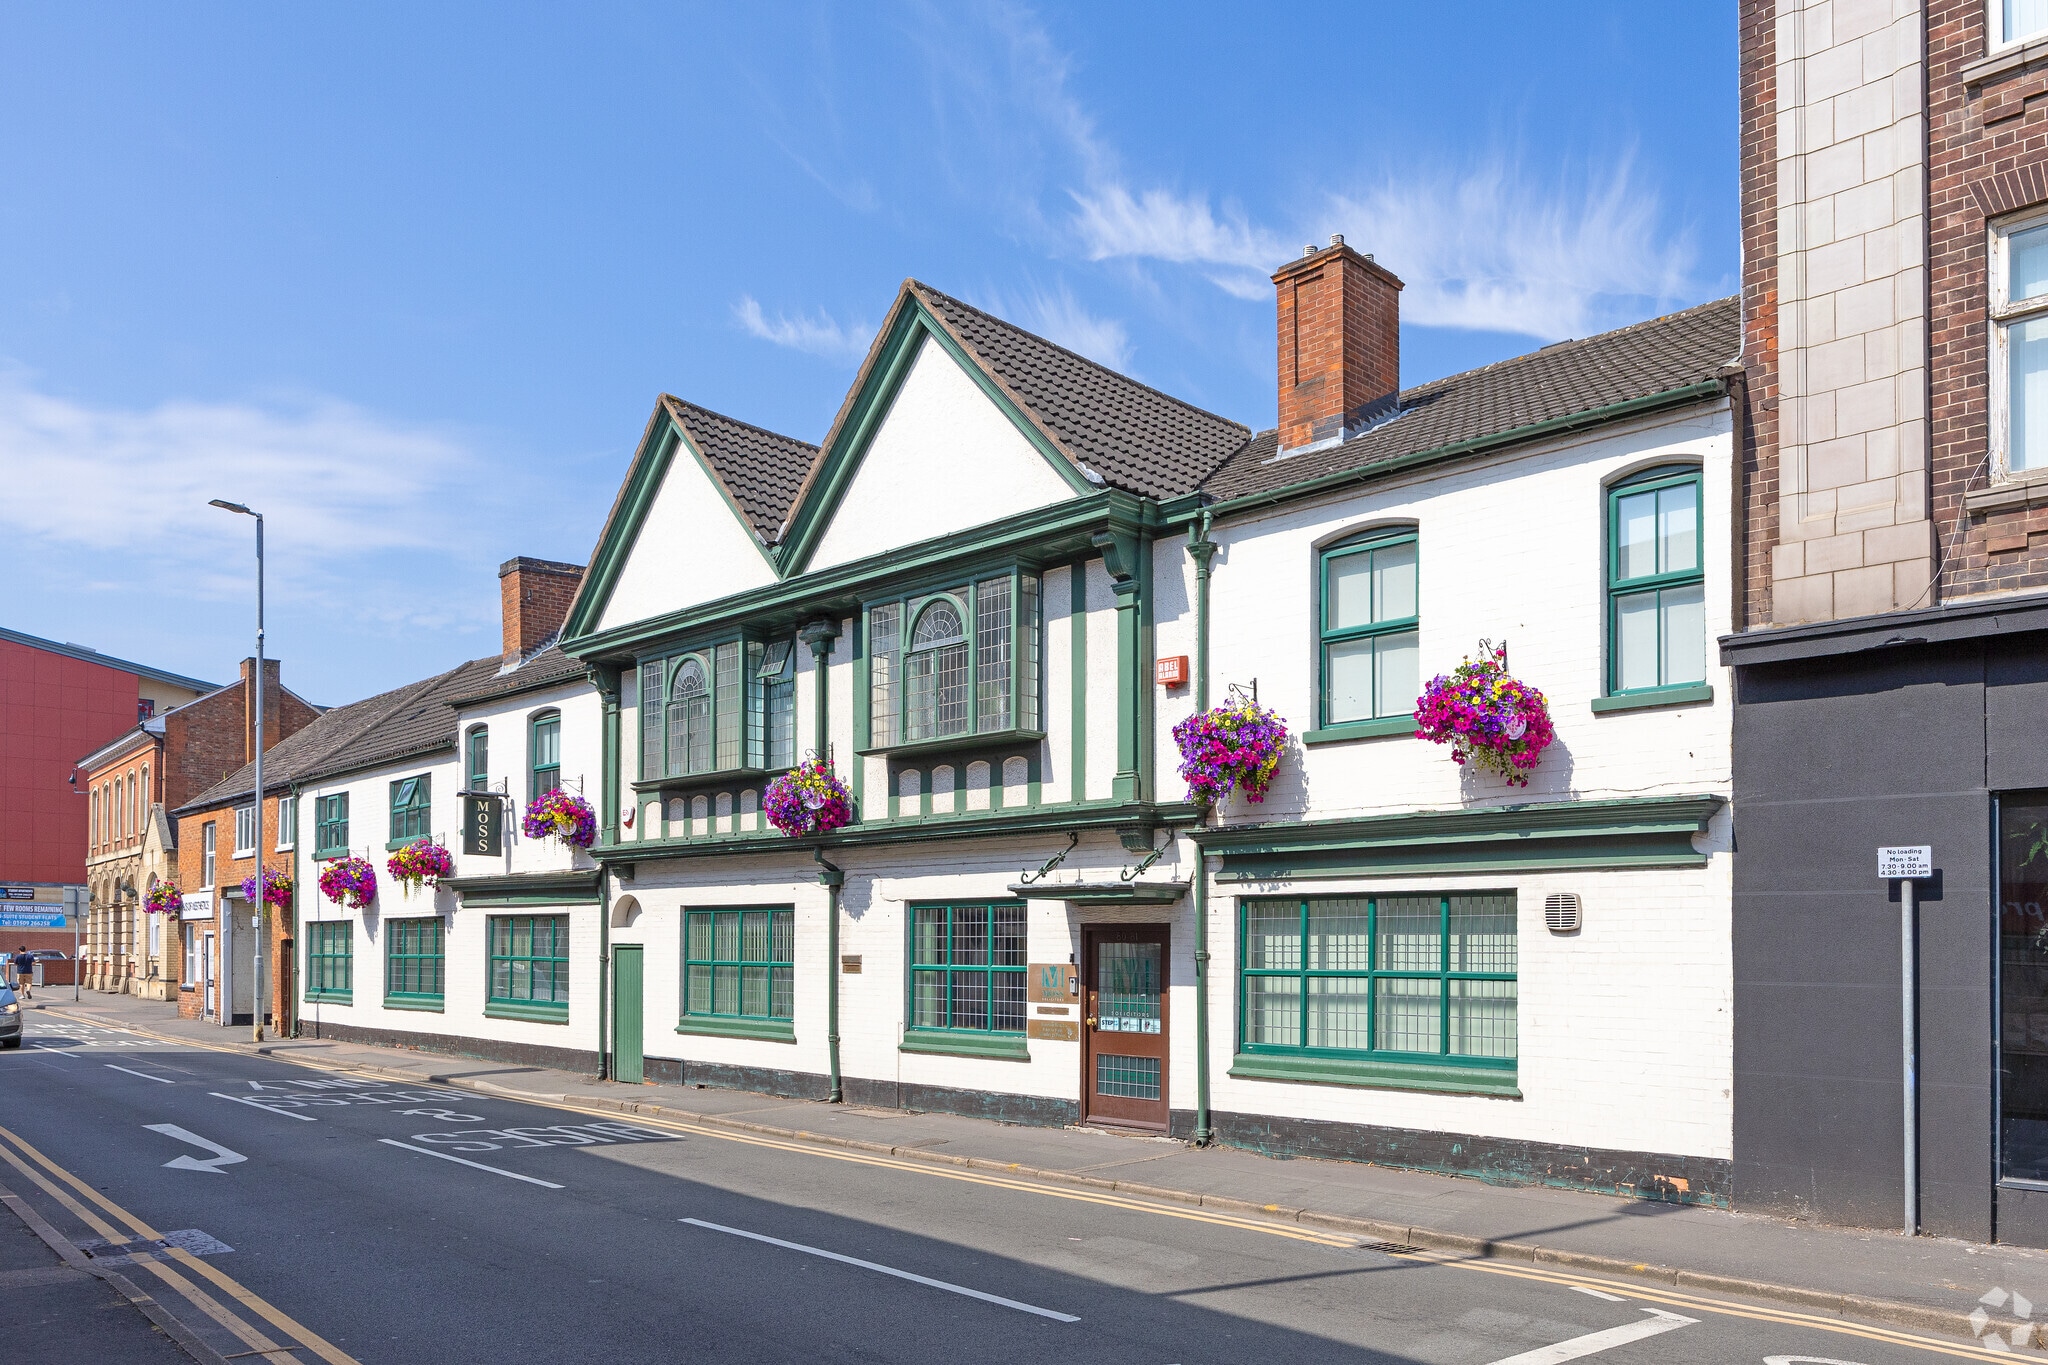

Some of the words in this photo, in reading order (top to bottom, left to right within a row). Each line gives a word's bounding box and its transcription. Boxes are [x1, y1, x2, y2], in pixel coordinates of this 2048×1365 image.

[1158, 661, 1178, 672] ABEL
[477, 800, 490, 852] MOSS
[3, 904, 14, 912] FEW
[15, 905, 34, 913] ROOMS
[34, 905, 63, 913] REMAINING
